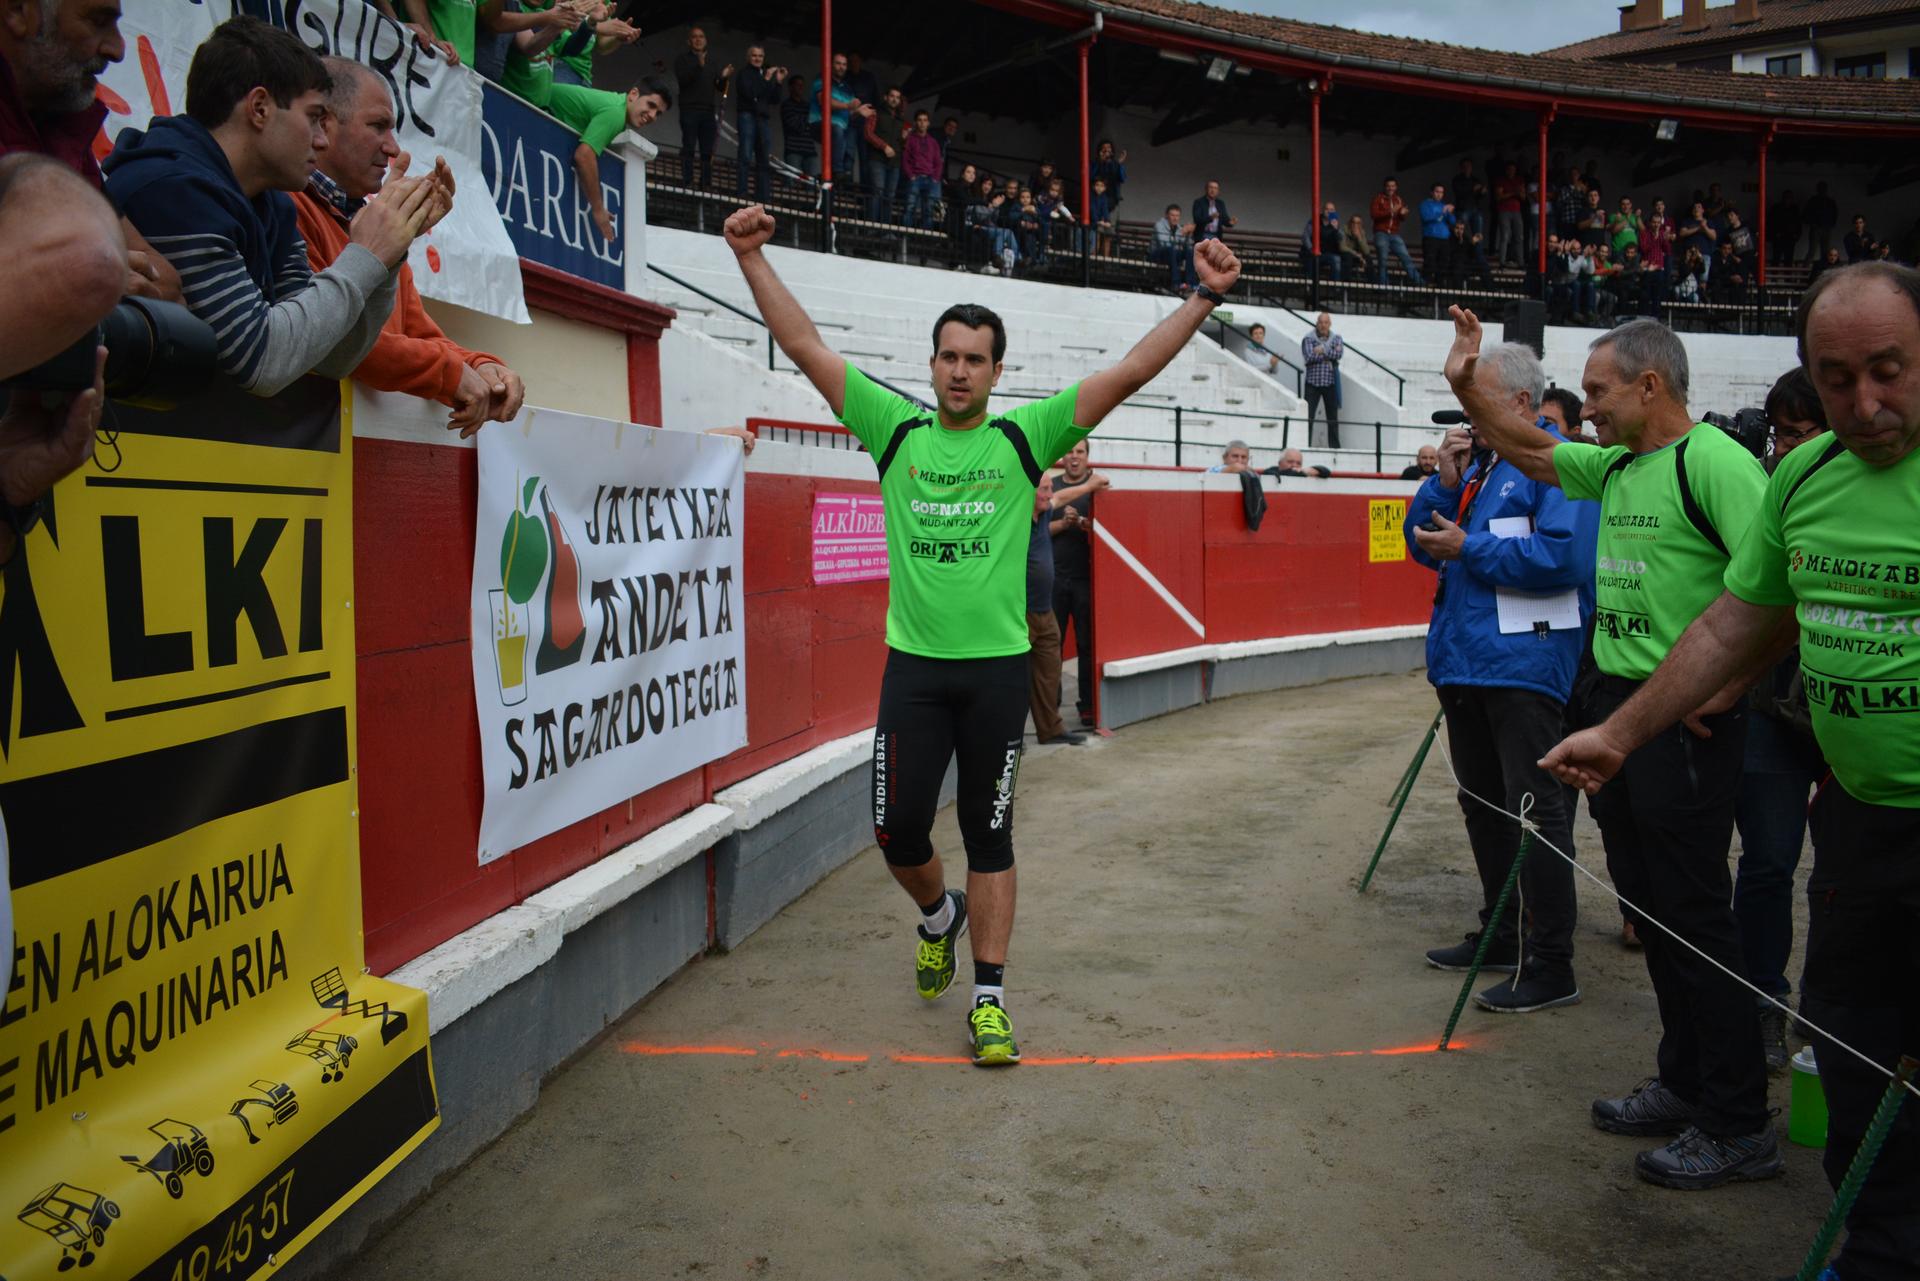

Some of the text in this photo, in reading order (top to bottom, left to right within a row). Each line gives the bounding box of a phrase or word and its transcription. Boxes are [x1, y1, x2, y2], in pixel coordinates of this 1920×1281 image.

[585, 485, 732, 546] JATETXEA
[910, 499, 995, 516] GOENATXO
[919, 517, 981, 528] MUDANTZAK
[1808, 631, 1905, 658] MUDANTZAK
[505, 656, 738, 792] SAGARDOTEGIA
[875, 733, 886, 827] MENDIZABAL
[72, 843, 294, 993] ALOKAIRUA
[35, 929, 289, 1112] MAQUINARIA
[215, 1204, 257, 1274] 45
[261, 1168, 295, 1241] 57
